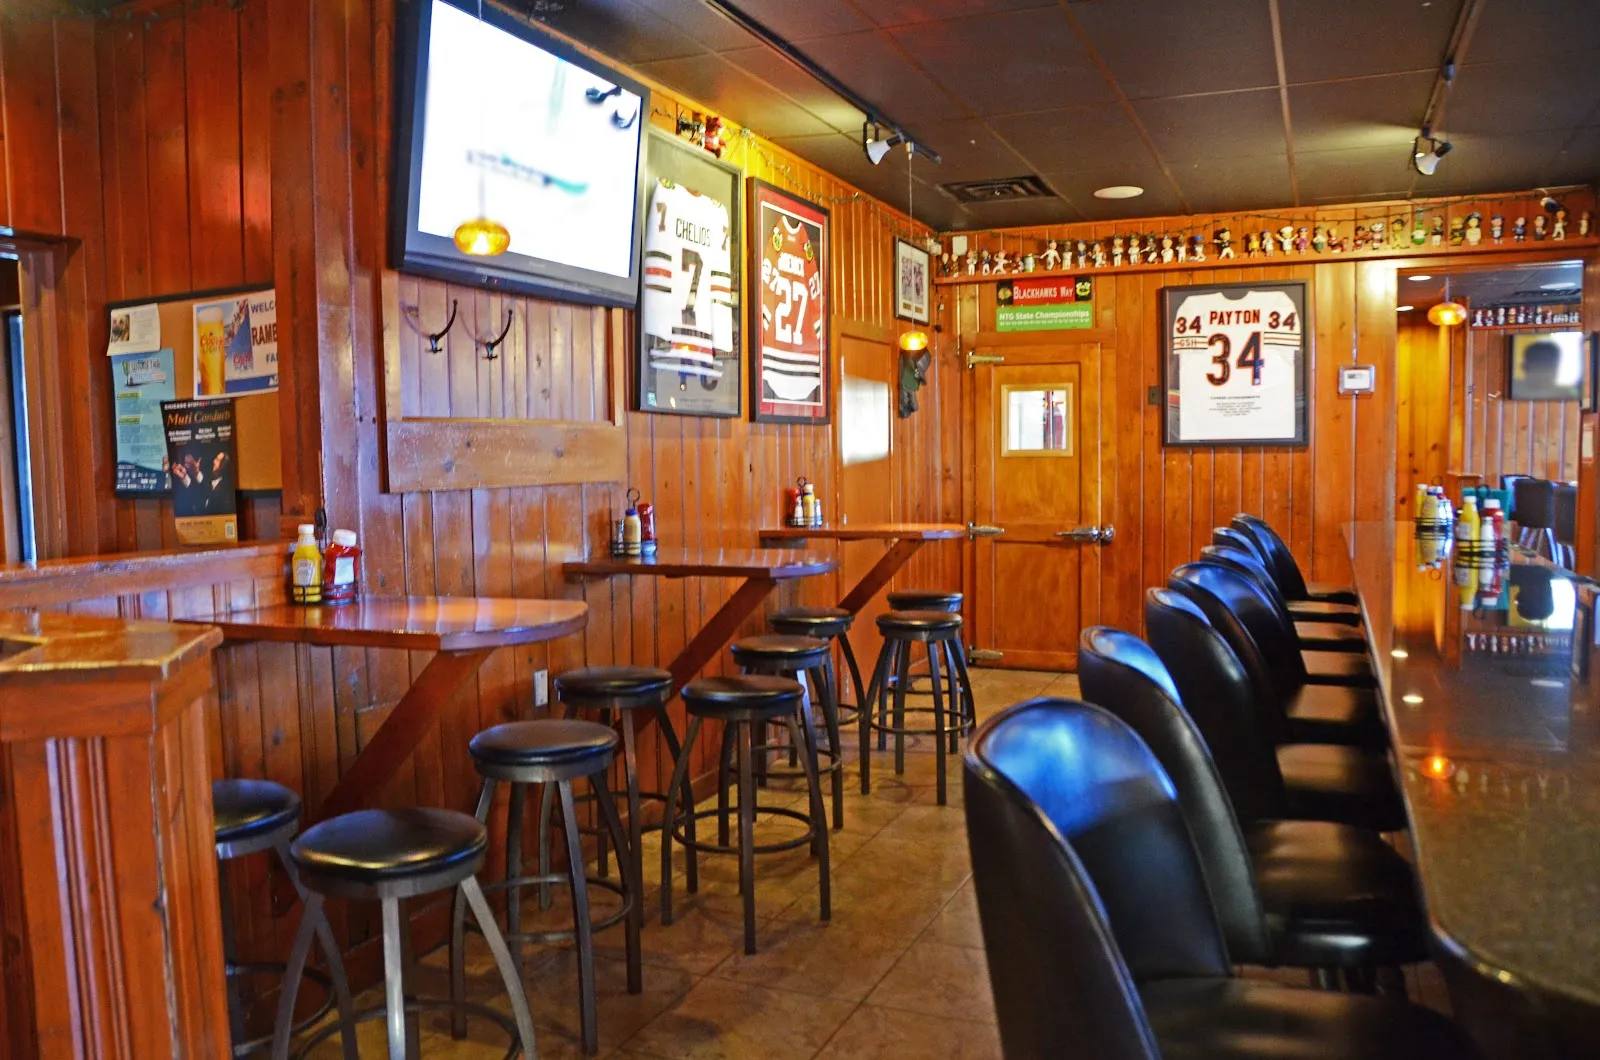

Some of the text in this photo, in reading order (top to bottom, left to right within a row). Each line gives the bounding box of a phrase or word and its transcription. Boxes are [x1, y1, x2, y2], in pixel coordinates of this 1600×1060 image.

[656, 202, 668, 232] 7
[675, 217, 711, 247] CHELIOS
[721, 225, 729, 252] 7
[681, 247, 703, 326] 7
[251, 301, 274, 313] WELC
[775, 276, 809, 345] 27
[1016, 312, 1034, 320] State
[1035, 310, 1090, 320] Championships
[1176, 316, 1202, 334] 34
[1209, 309, 1261, 325] PAYTON
[1268, 311, 1296, 330] 34
[1179, 339, 1197, 347] GSH
[1206, 331, 1265, 386] 34
[167, 411, 193, 426] Muti
